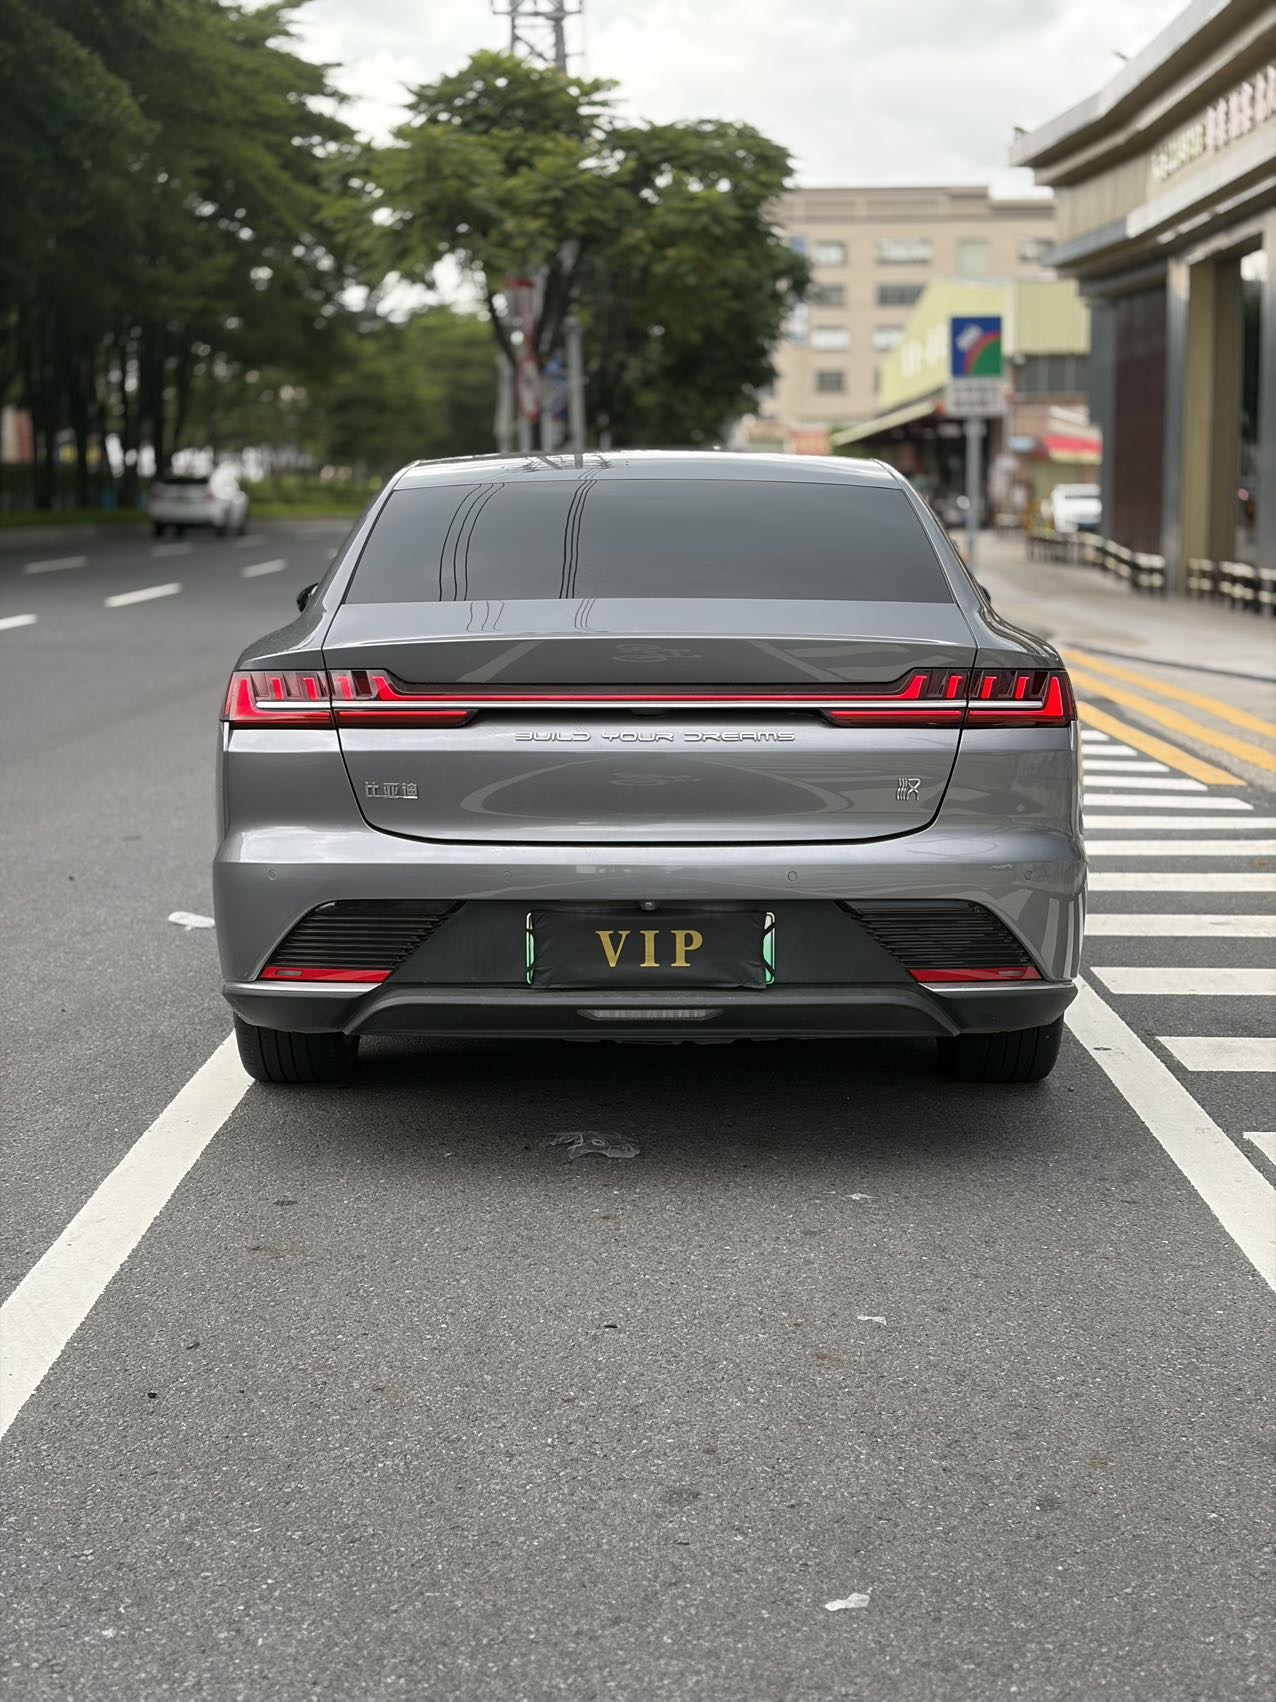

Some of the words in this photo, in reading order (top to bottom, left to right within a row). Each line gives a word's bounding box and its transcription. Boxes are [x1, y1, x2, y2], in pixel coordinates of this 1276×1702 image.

[514, 731, 591, 742] BUILD
[601, 731, 674, 742] YOUR
[683, 731, 796, 742] DREAMS
[364, 781, 419, 800] 比亚迪
[595, 929, 703, 968] VIP
